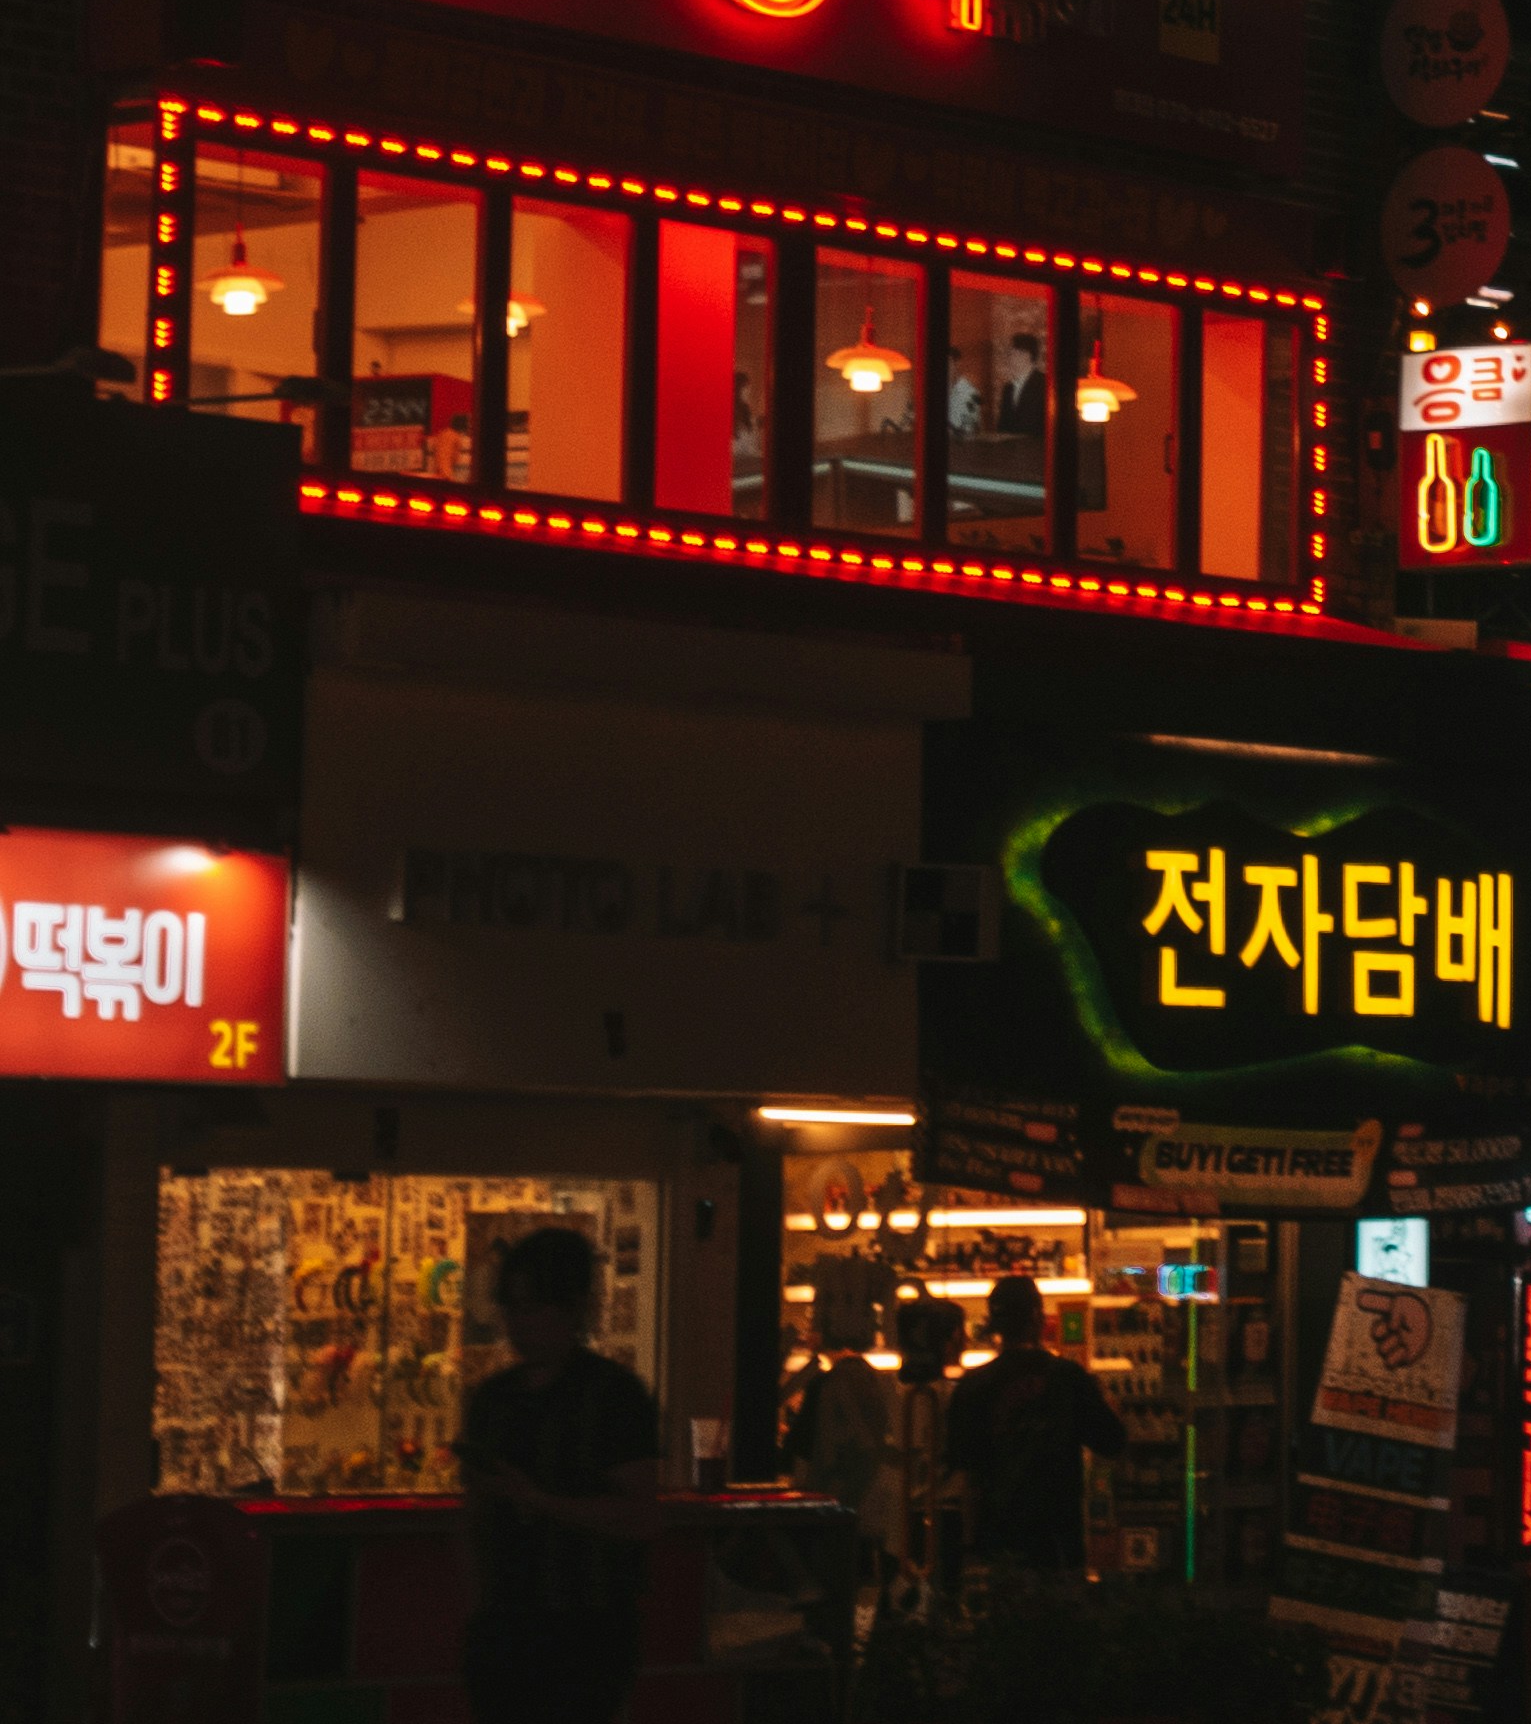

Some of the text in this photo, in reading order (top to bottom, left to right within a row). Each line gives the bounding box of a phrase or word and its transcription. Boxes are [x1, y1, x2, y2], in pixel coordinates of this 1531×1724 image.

[116, 579, 275, 678] PLUS
[13, 900, 207, 1021] 떡볶이
[1141, 847, 1515, 1031] 전자담배
[209, 1019, 260, 1070] 2F
[1290, 1148, 1355, 1176] FREE
